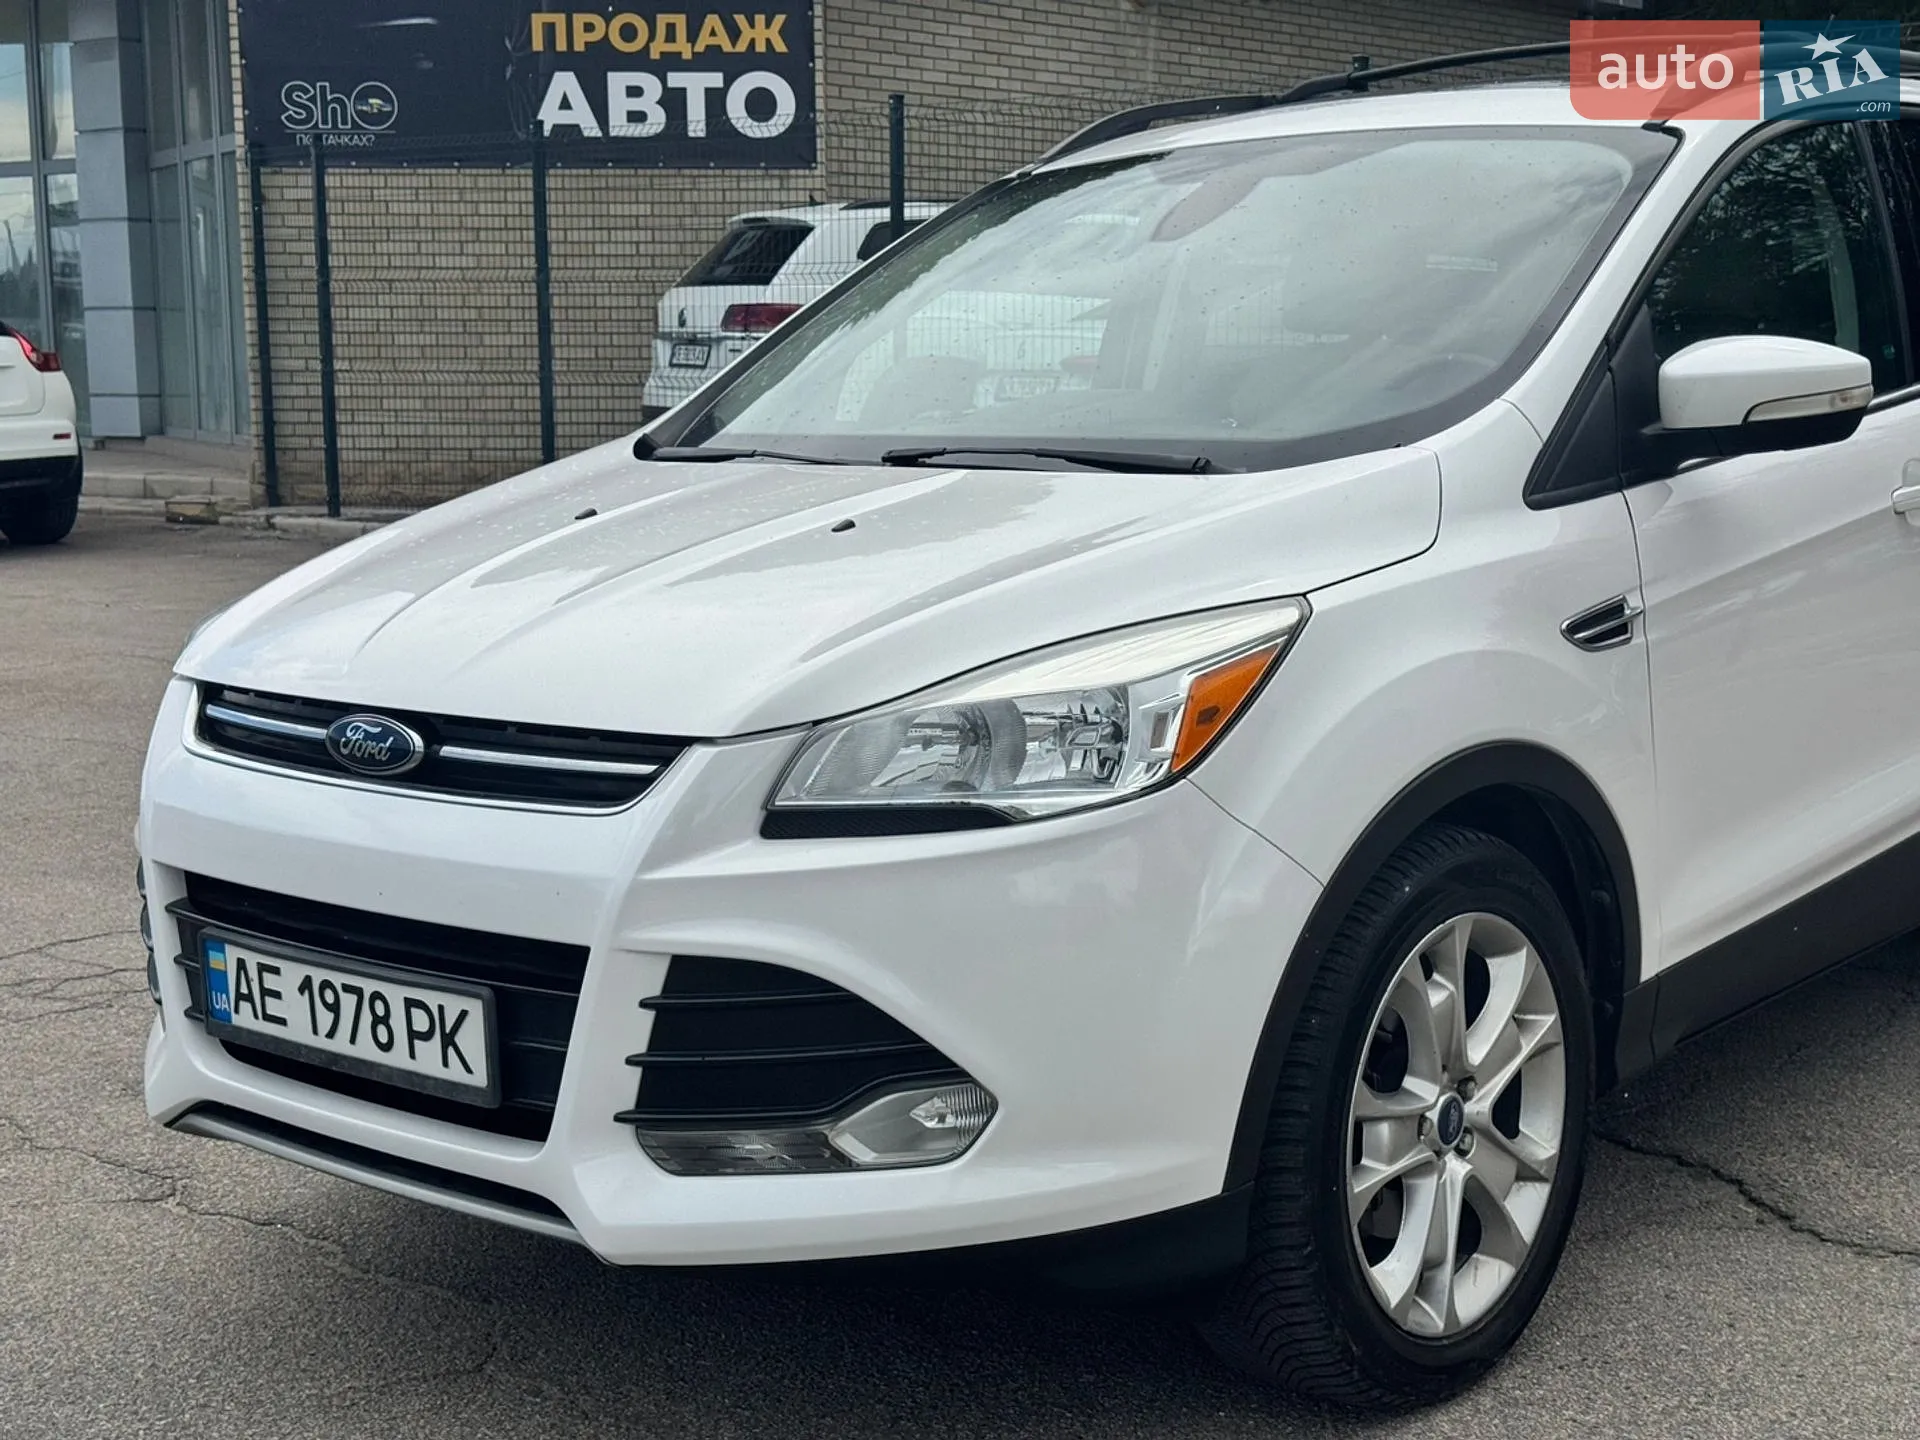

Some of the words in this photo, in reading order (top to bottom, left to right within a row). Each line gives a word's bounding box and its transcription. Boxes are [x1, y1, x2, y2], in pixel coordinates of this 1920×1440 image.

[530, 13, 788, 60] ПРОДАЖ
[536, 71, 796, 138] АВТО
[340, 722, 394, 761] Ford
[211, 991, 231, 1012] UA
[233, 957, 287, 1026] AE
[297, 975, 394, 1052] 1978
[403, 996, 474, 1075] PK
